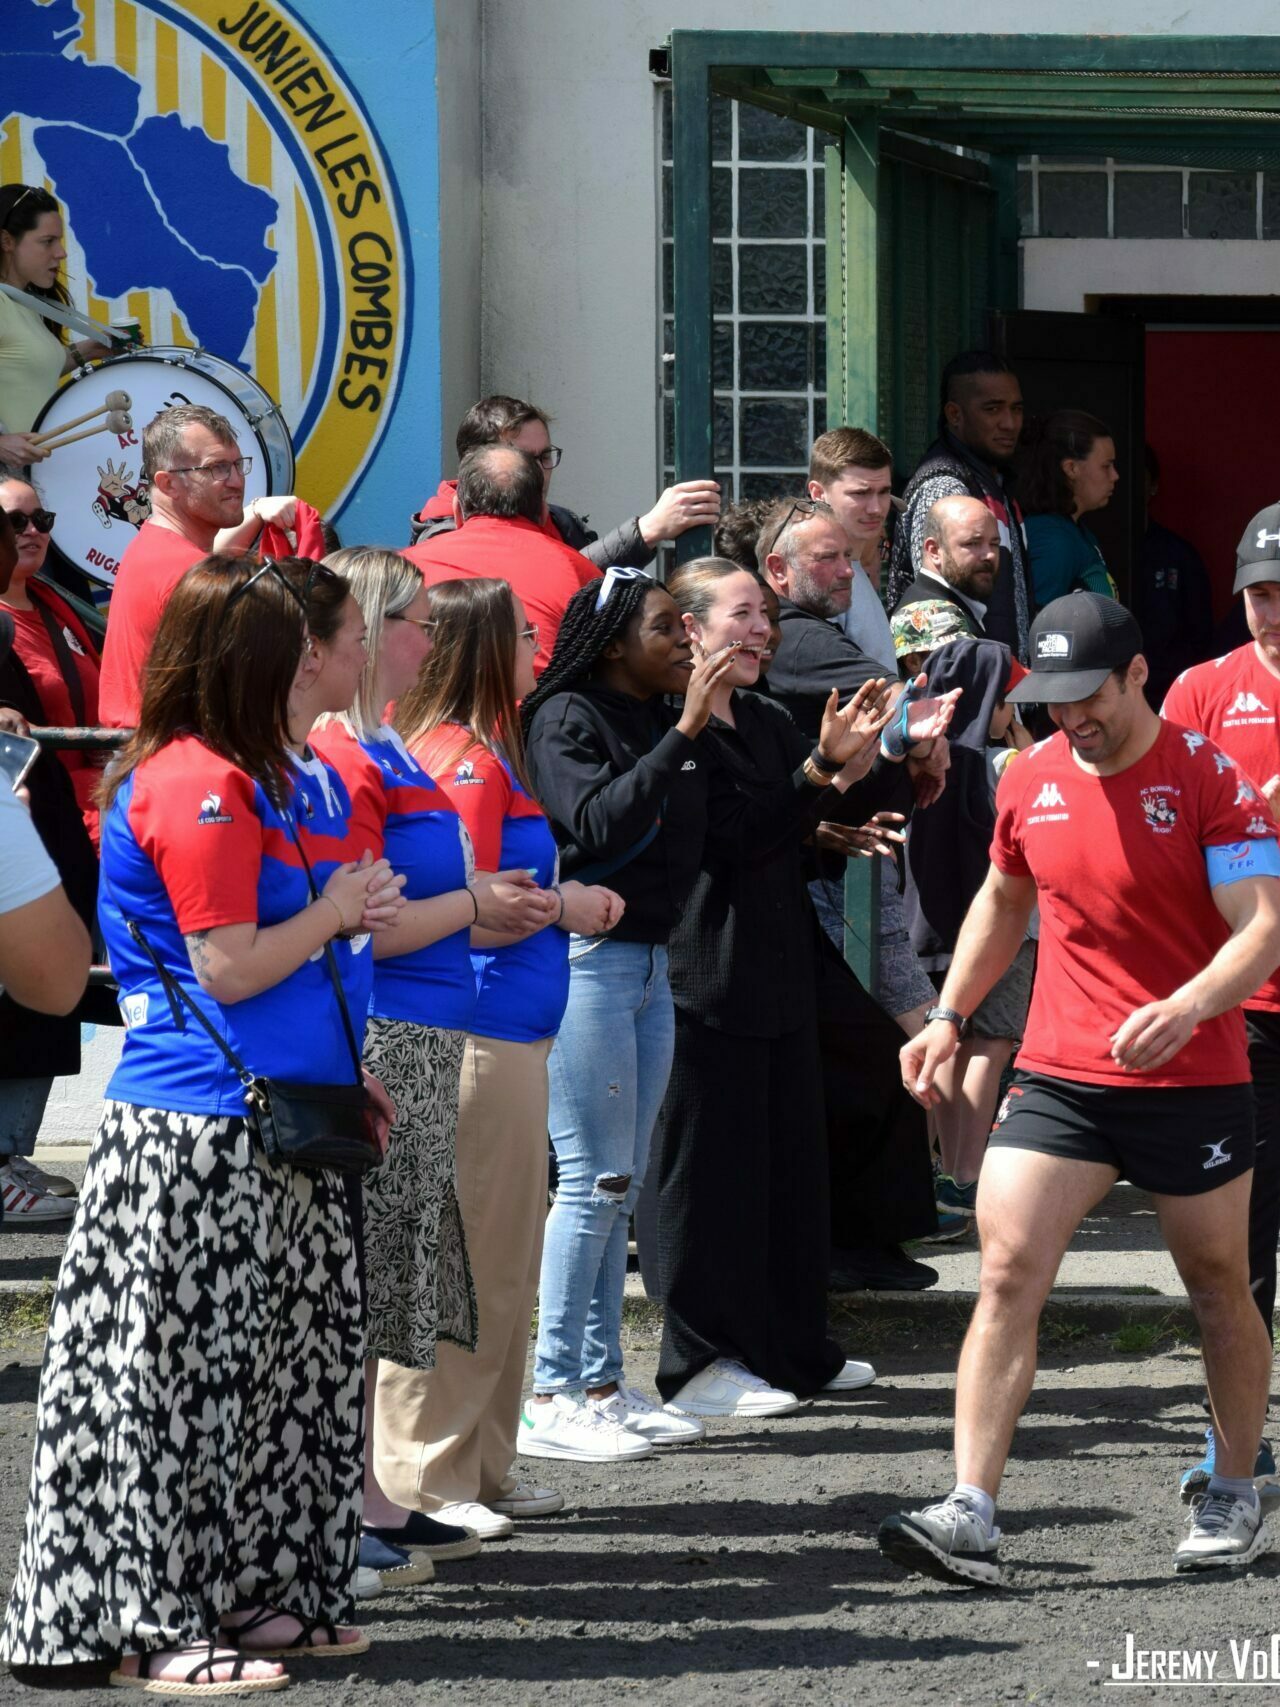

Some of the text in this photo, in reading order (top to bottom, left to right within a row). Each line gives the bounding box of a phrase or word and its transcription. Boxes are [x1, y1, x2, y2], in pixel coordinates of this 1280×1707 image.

[218, 1, 393, 412] JUNIEN LES COMBES
[1229, 860, 1254, 870] FFR
[1203, 1153, 1231, 1170] GILBERT
